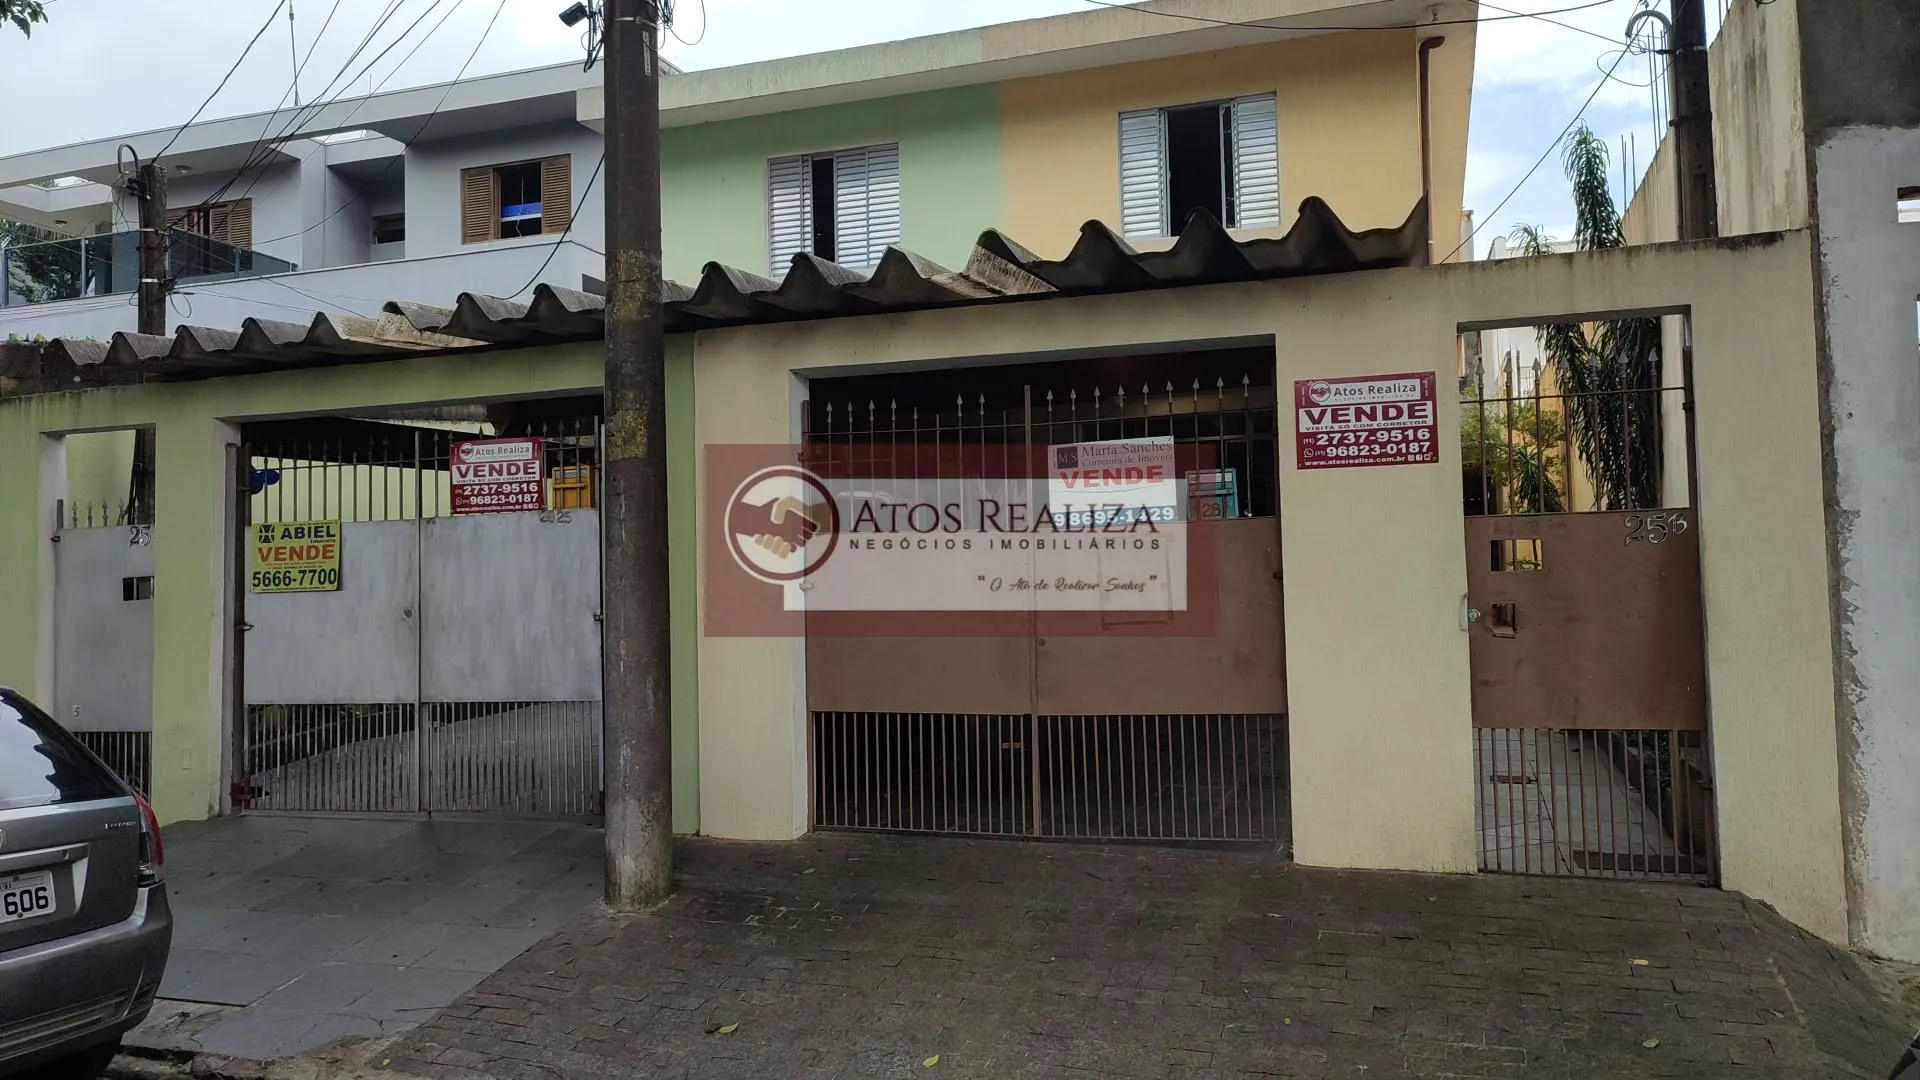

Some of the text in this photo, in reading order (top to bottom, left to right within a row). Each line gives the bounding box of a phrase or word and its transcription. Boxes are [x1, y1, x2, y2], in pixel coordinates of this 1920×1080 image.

[1333, 386, 1364, 397] Atos
[1368, 383, 1417, 395] Realiza
[1303, 402, 1429, 425] VENDE
[1315, 428, 1431, 446] 2737-9516
[475, 447, 495, 456] Atos
[497, 445, 530, 455] Realiza
[1121, 440, 1173, 454] Sanches
[1326, 441, 1431, 457] 96823-0187
[1082, 457, 1123, 467] Corretora
[1125, 456, 1135, 464] de
[1304, 455, 1406, 466] www.atosrealiza.com.br
[455, 461, 537, 479] VENDE
[1060, 465, 1164, 489] VENDE
[463, 482, 539, 495] 2737-9516
[469, 493, 539, 505] 96823-0187
[129, 525, 152, 548] 25
[280, 525, 336, 540] ABIEL
[257, 543, 335, 562] VENDE
[252, 568, 337, 588] 5666-7700
